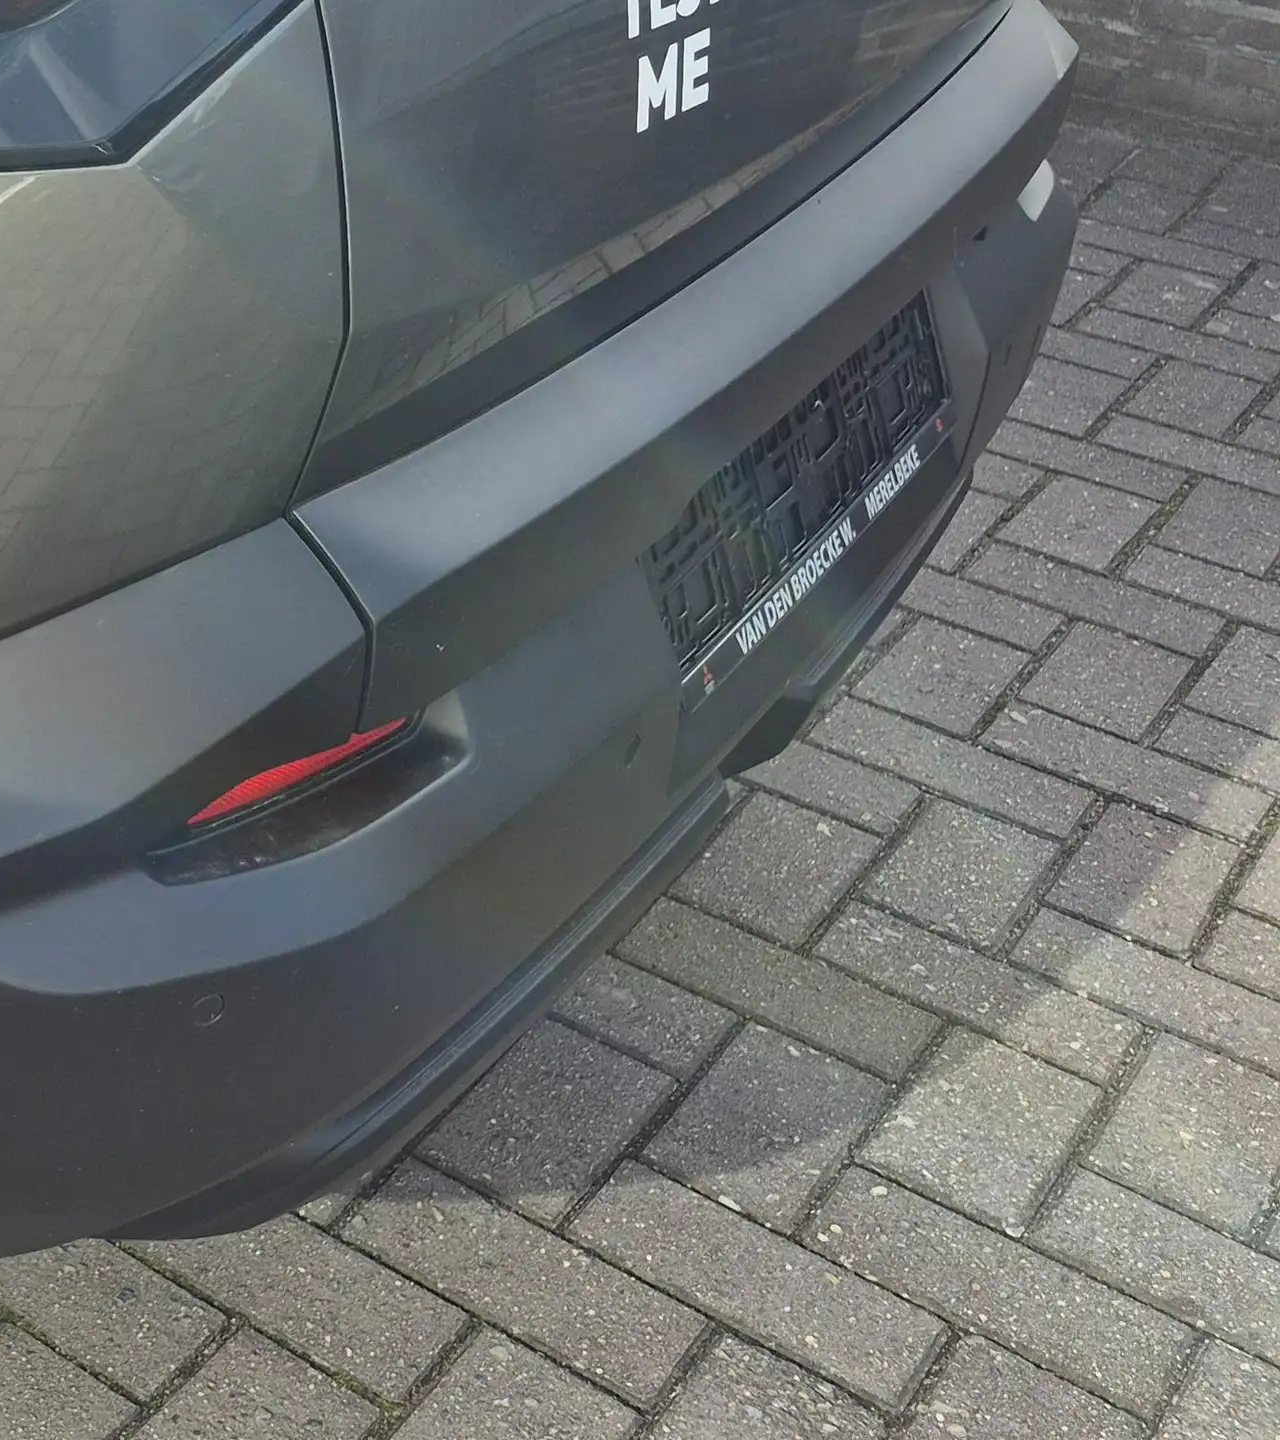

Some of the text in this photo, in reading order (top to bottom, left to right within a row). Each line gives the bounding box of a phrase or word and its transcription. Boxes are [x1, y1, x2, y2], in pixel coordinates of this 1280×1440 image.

[636, 26, 712, 134] ME
[734, 442, 922, 656] VAN DEN BROECKE W. MERELBEKE
